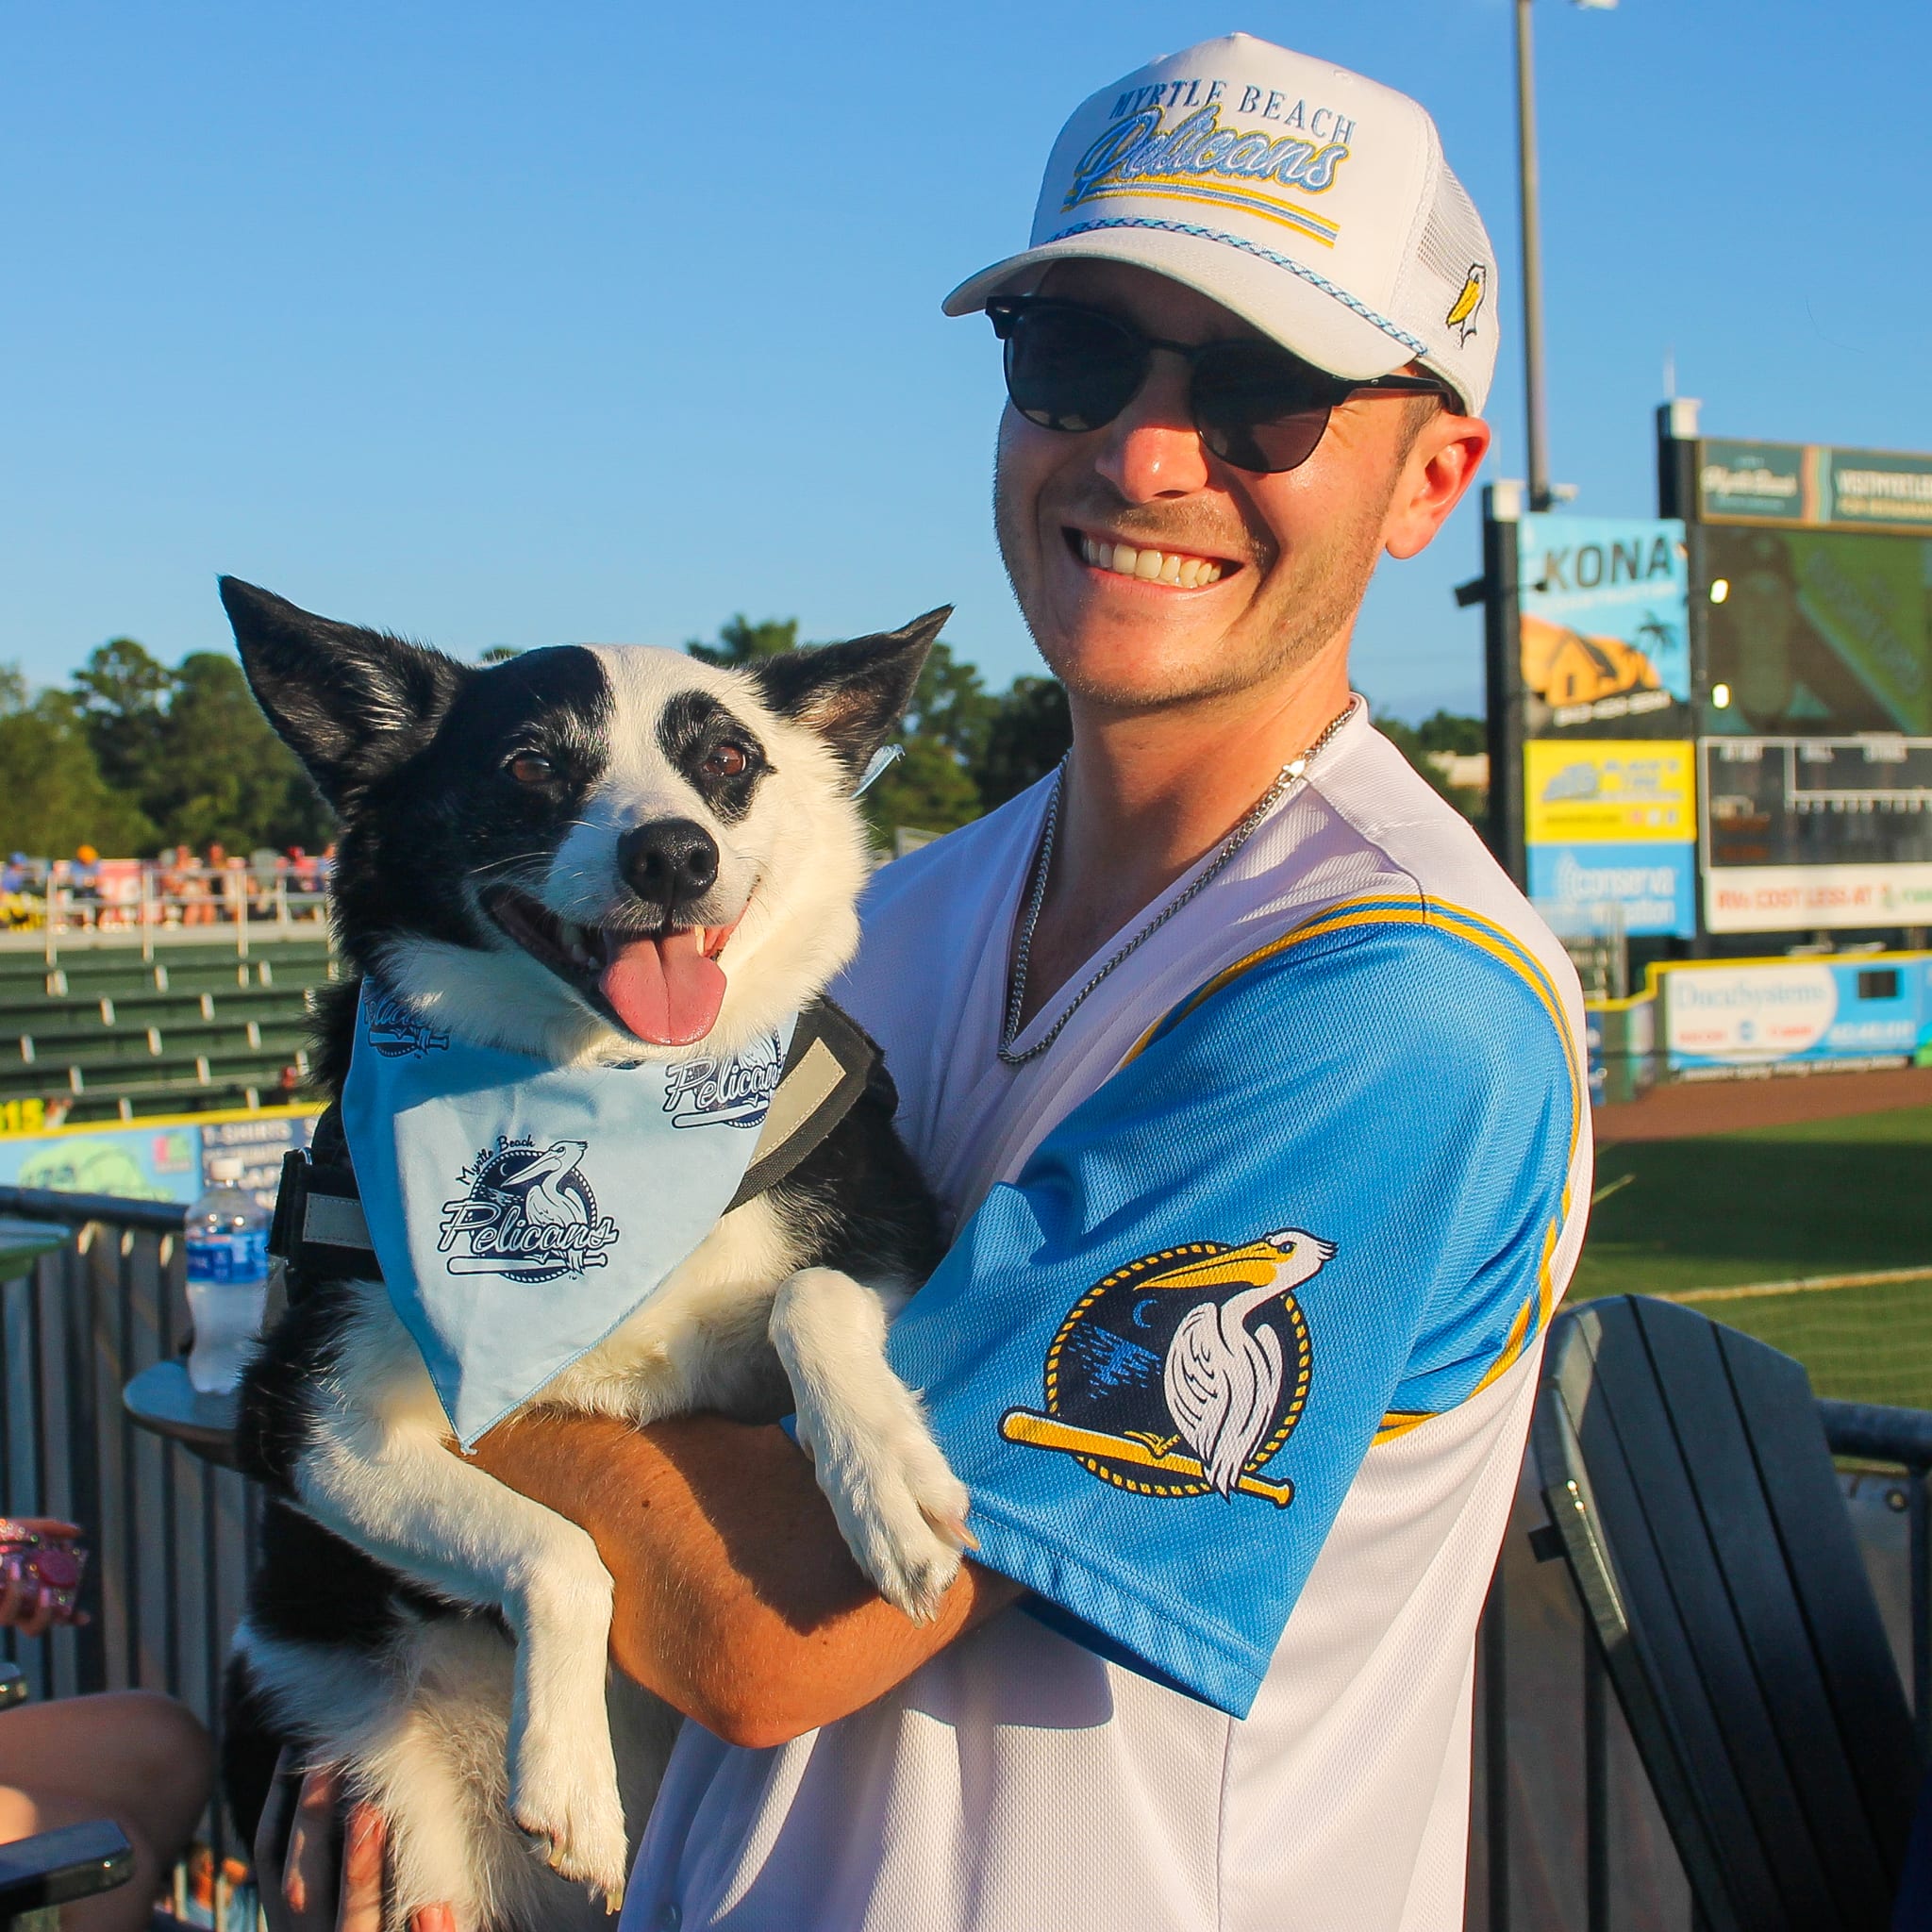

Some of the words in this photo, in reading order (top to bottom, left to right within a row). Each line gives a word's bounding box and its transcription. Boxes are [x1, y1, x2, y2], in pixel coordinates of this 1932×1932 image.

[1237, 83, 1357, 145] BEACH
[1544, 536, 1673, 591] KONA
[455, 1147, 493, 1186] Myrtle
[496, 1134, 536, 1152] Beach
[437, 1198, 619, 1254] Pelicans
